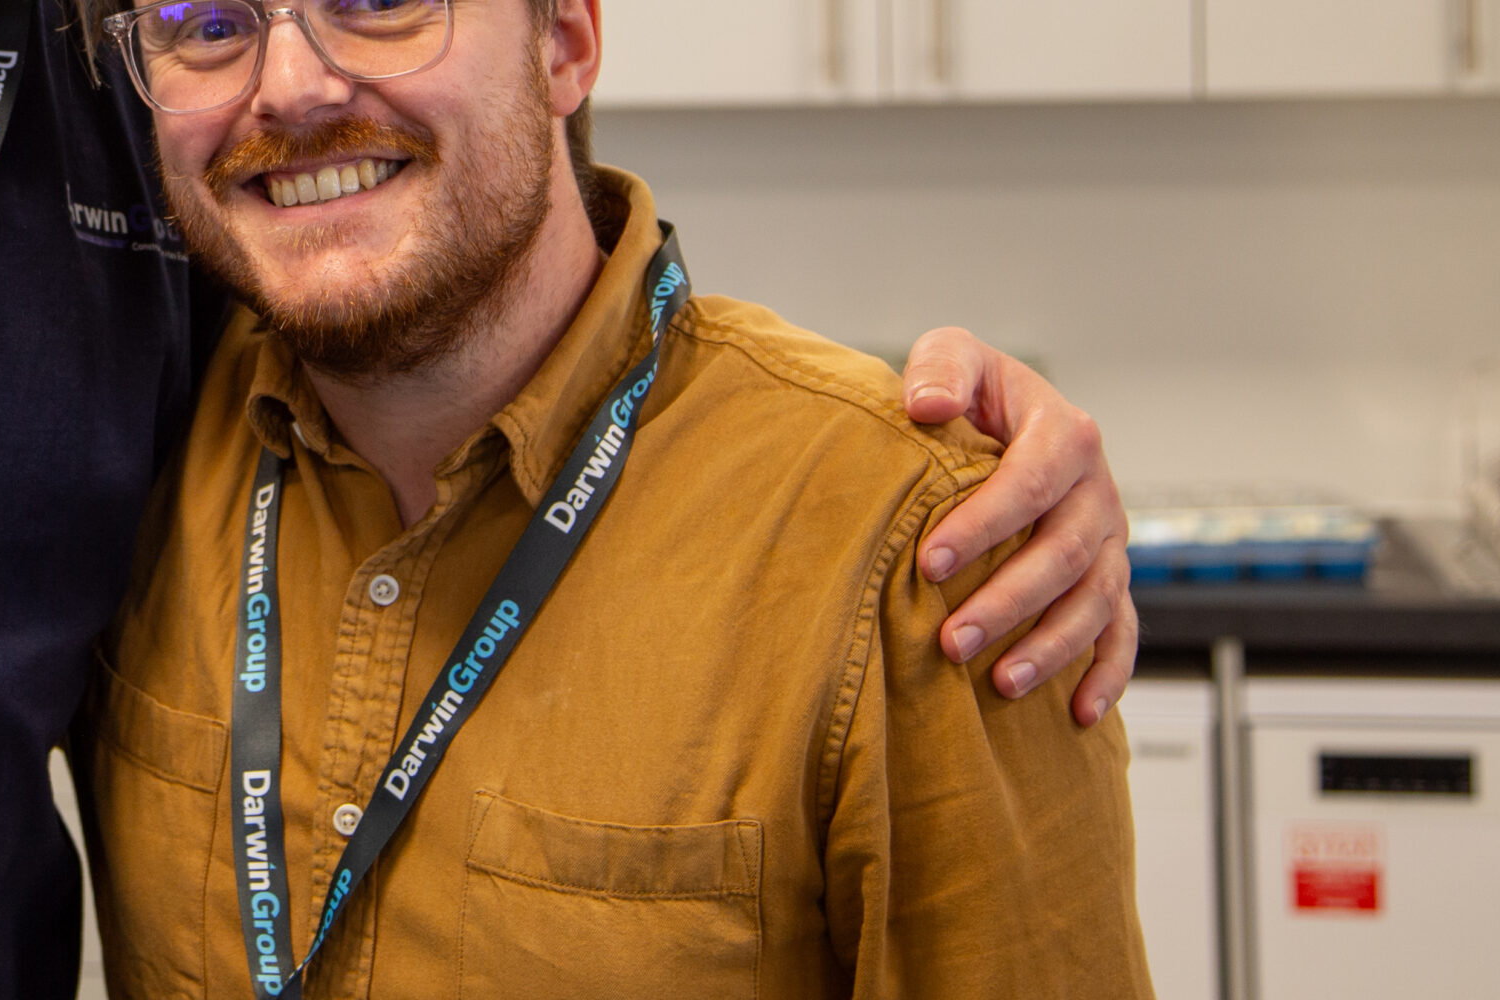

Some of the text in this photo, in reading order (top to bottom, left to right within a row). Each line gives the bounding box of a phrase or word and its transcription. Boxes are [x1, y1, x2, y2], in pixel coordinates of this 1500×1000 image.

[239, 482, 275, 693] DarwinGroup
[384, 599, 520, 801] DarwinGroup
[243, 769, 284, 997] DarwinGroup
